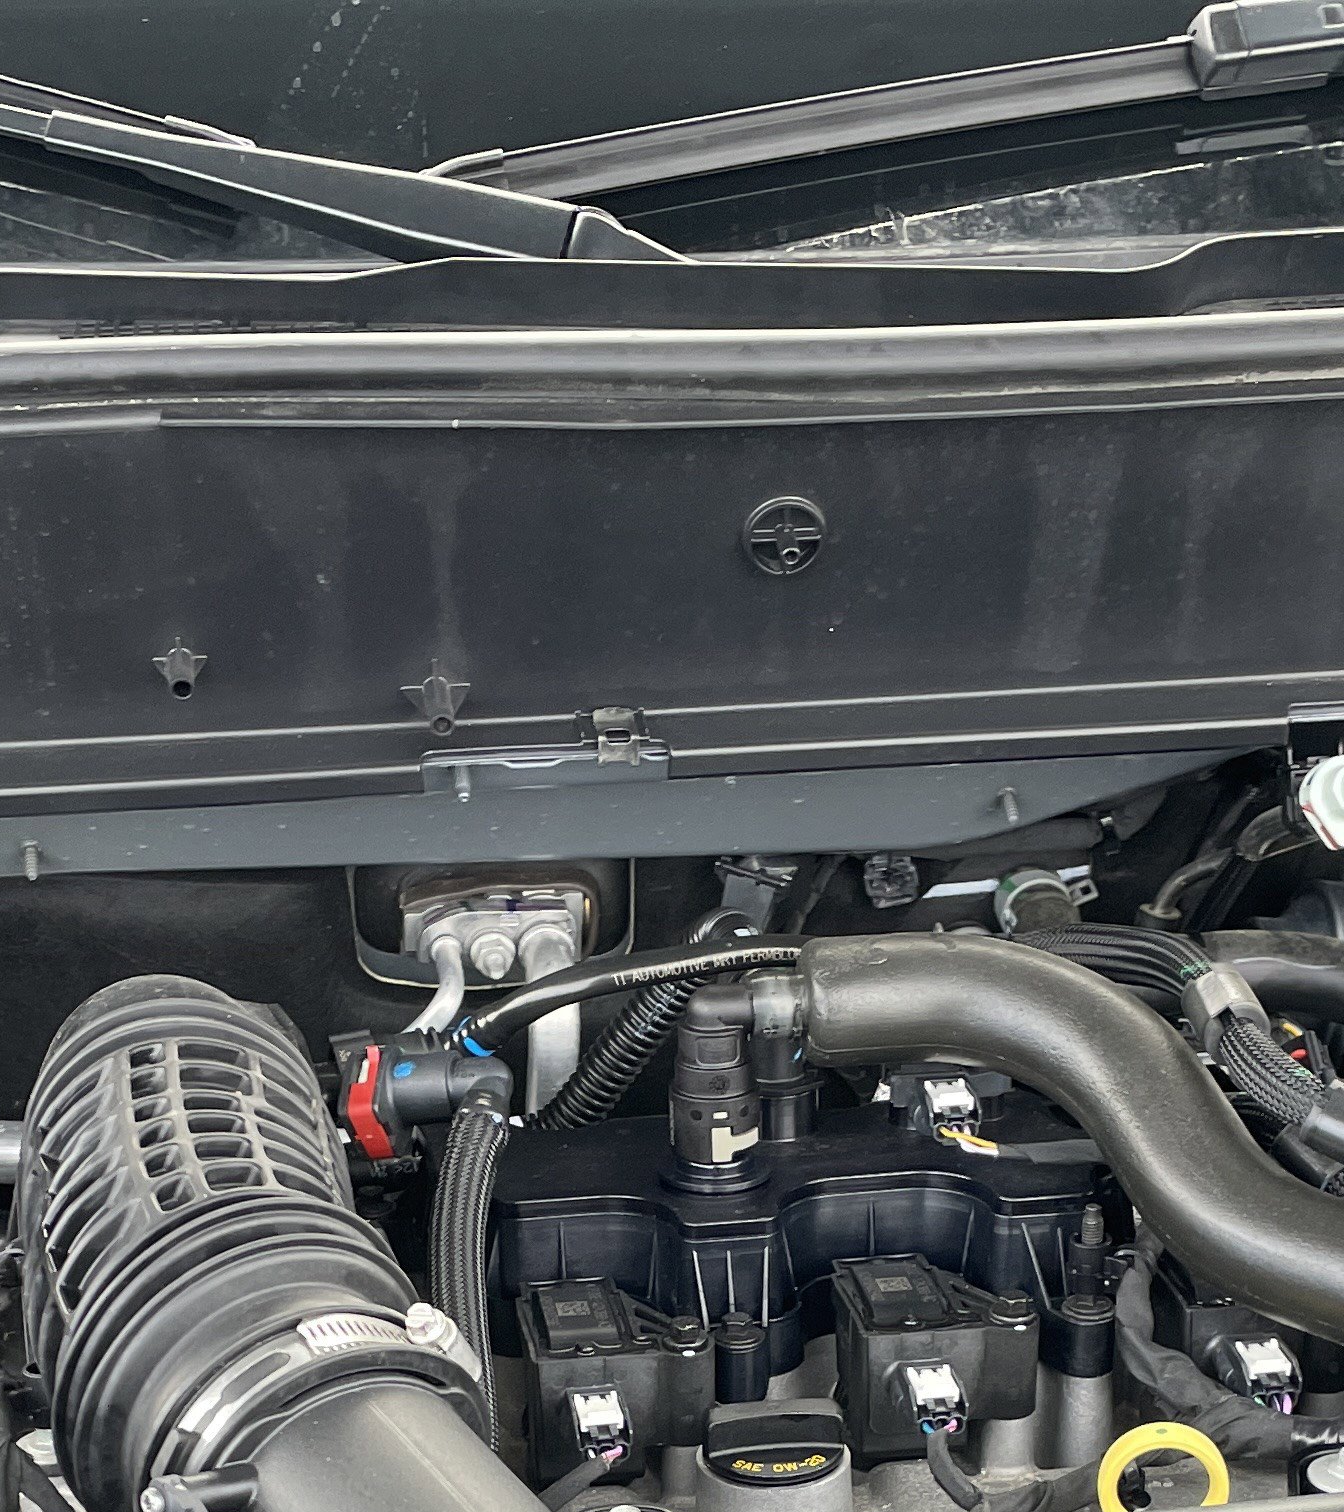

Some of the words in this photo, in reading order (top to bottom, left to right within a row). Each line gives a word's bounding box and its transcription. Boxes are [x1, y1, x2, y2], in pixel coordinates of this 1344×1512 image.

[611, 973, 627, 986] TI
[631, 960, 710, 984] AUTOMOTIVE
[731, 1459, 765, 1473] SAE
